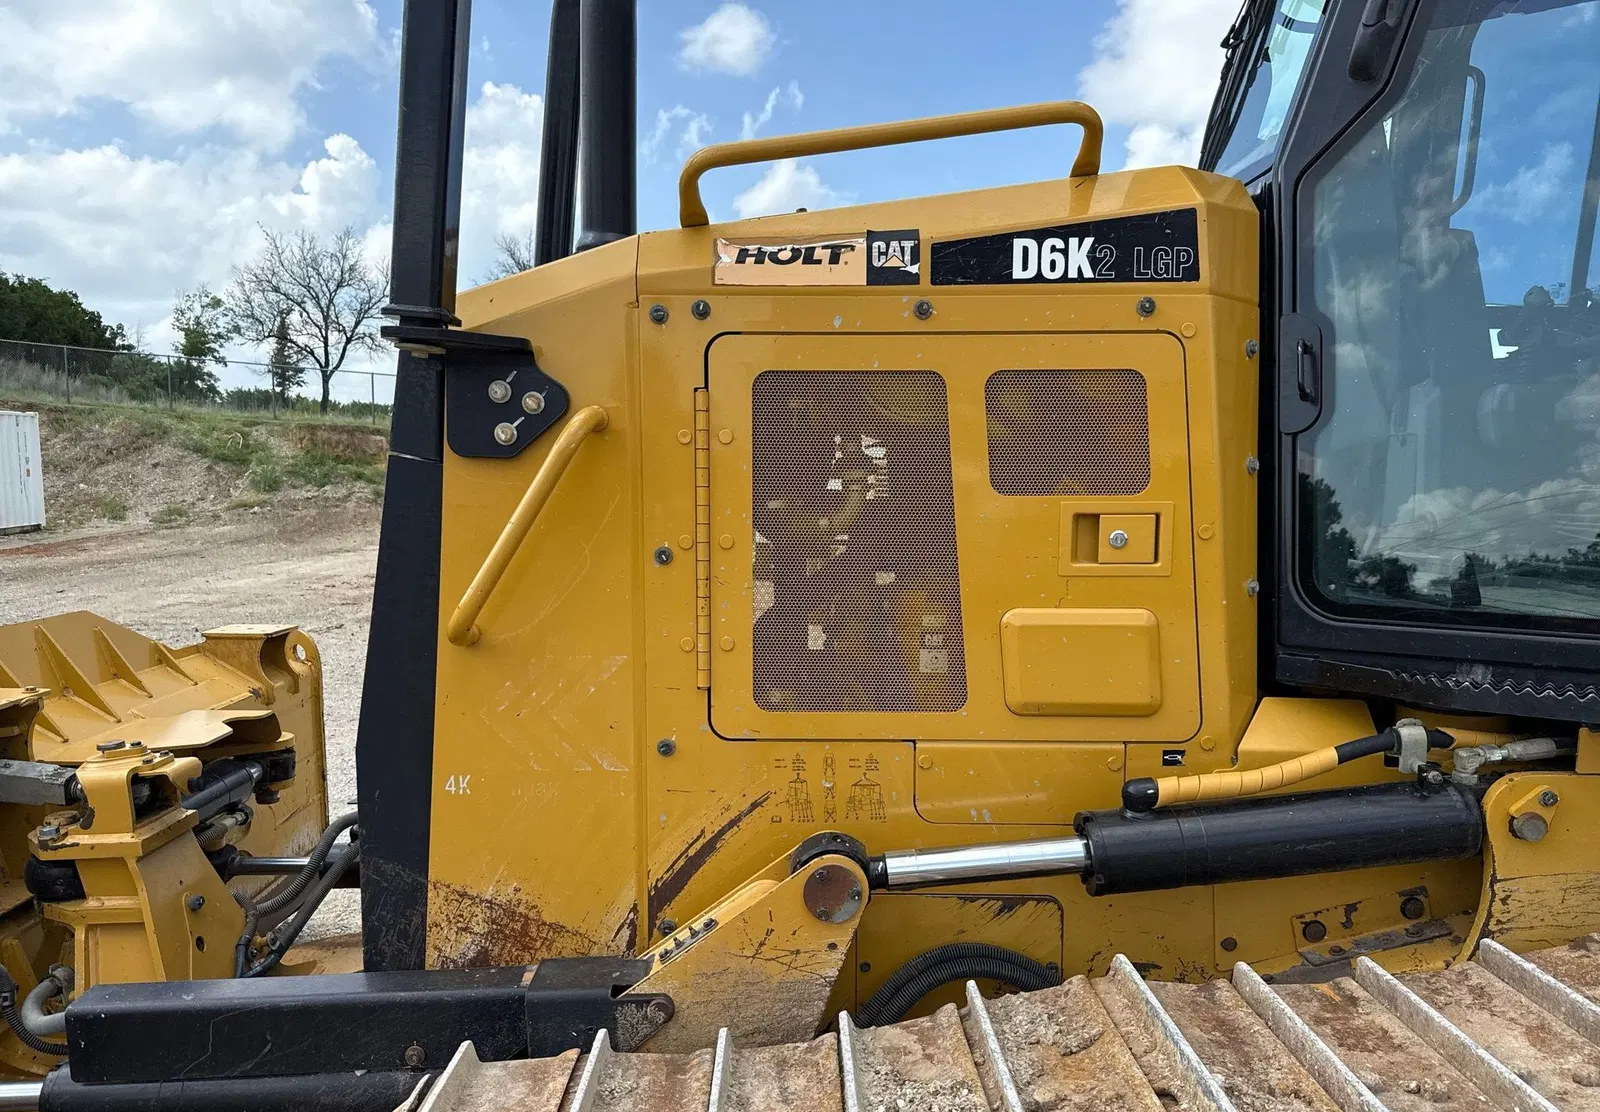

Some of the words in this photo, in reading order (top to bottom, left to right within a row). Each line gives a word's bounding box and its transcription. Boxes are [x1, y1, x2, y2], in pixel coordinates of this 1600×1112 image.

[734, 245, 856, 265] HOLT
[872, 240, 914, 267] CAT
[1012, 236, 1116, 280] D6K2
[1133, 246, 1194, 278] LGP
[445, 774, 471, 795] 4K
